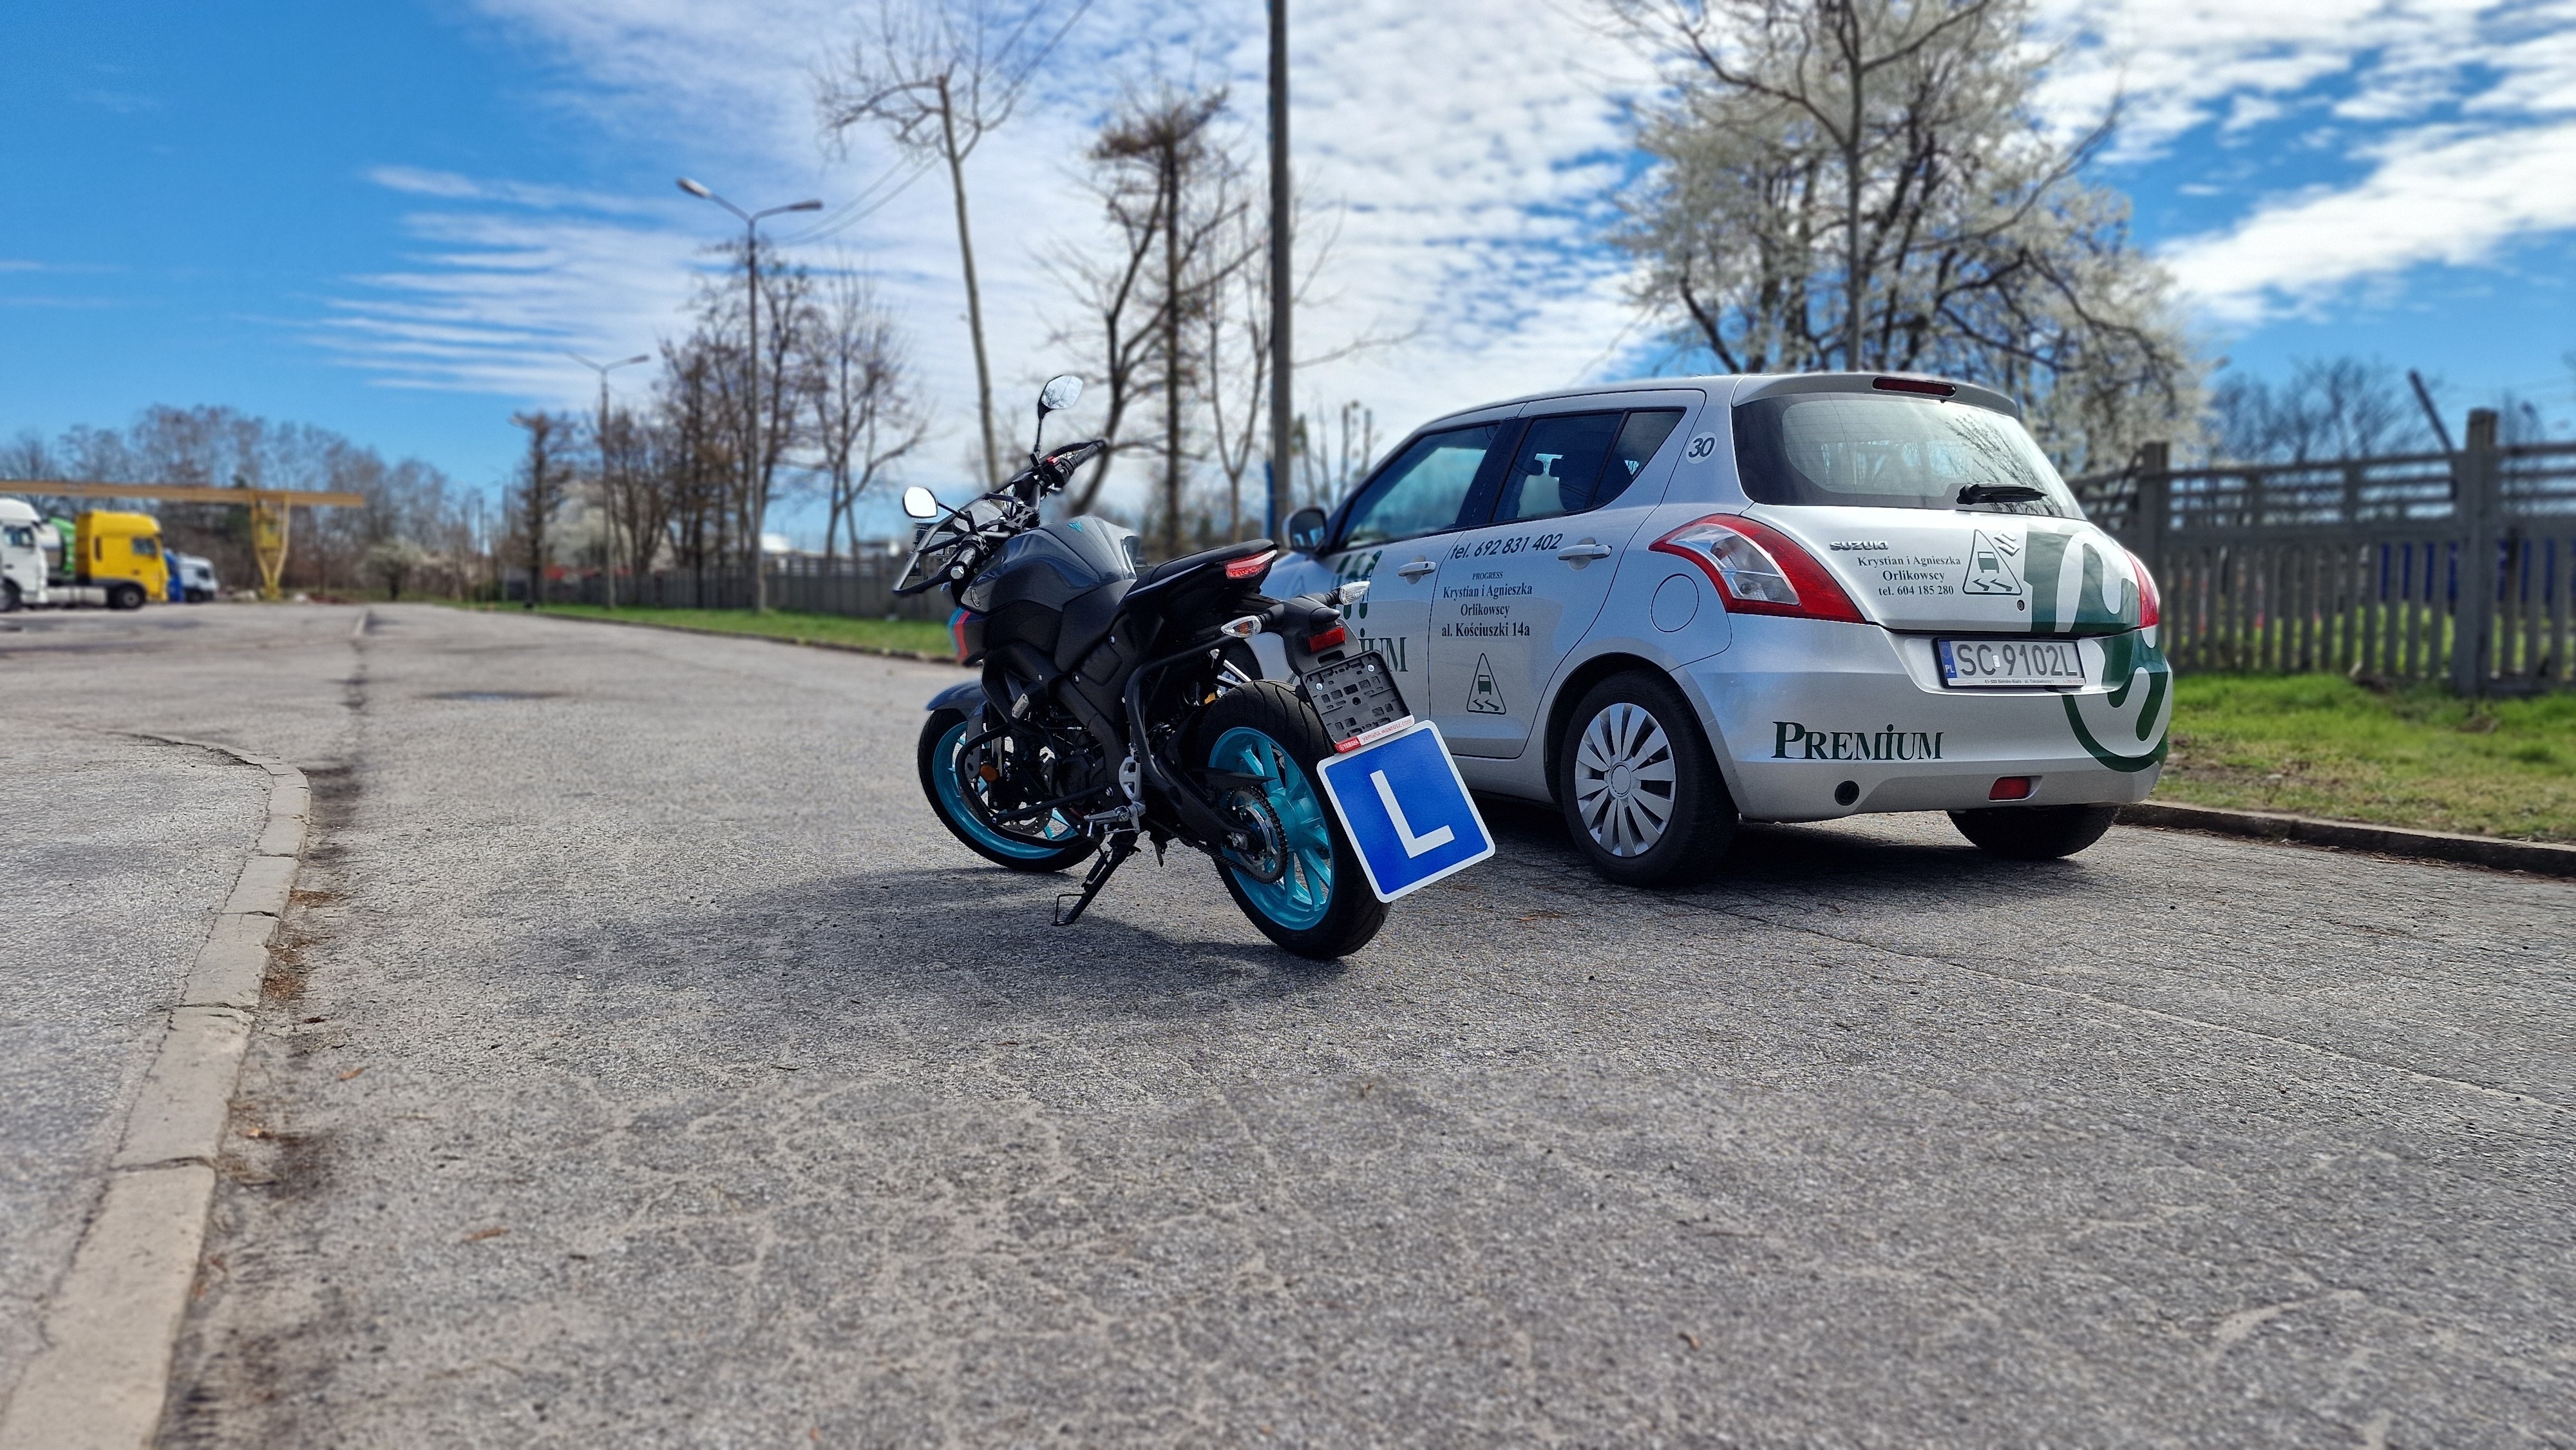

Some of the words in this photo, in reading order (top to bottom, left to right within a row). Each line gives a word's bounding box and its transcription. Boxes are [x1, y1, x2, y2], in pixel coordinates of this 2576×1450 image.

[1689, 437, 1715, 458] 30
[1450, 543, 1468, 560] tel.
[1474, 539, 1502, 557] 692
[1502, 536, 1530, 554] 831
[1532, 533, 1563, 551] 402
[1830, 540, 1889, 551] SUZUKI
[1857, 556, 1904, 568] Krystian
[1907, 556, 1910, 565] i
[1913, 556, 1961, 567] Agnieszka
[1472, 571, 1503, 580] PROGRESS
[1882, 570, 1945, 582] Orlikowscy
[1443, 585, 1479, 601] Krystian
[1481, 585, 1485, 597] i
[1486, 583, 1532, 599] Agnieszka
[1879, 586, 1894, 596] tel.
[1897, 586, 1915, 596] 604
[1918, 585, 1935, 595] 185
[1938, 585, 1954, 595] 280
[1461, 603, 1510, 618] Orlikowscy
[1442, 623, 1452, 637] al.
[1455, 622, 1510, 637] Kościuszki
[1512, 621, 1530, 636] 14a
[1956, 644, 1996, 676] SC
[2002, 644, 2078, 676] 9102L
[1945, 664, 1955, 673] PL
[1370, 769, 1455, 859] L
